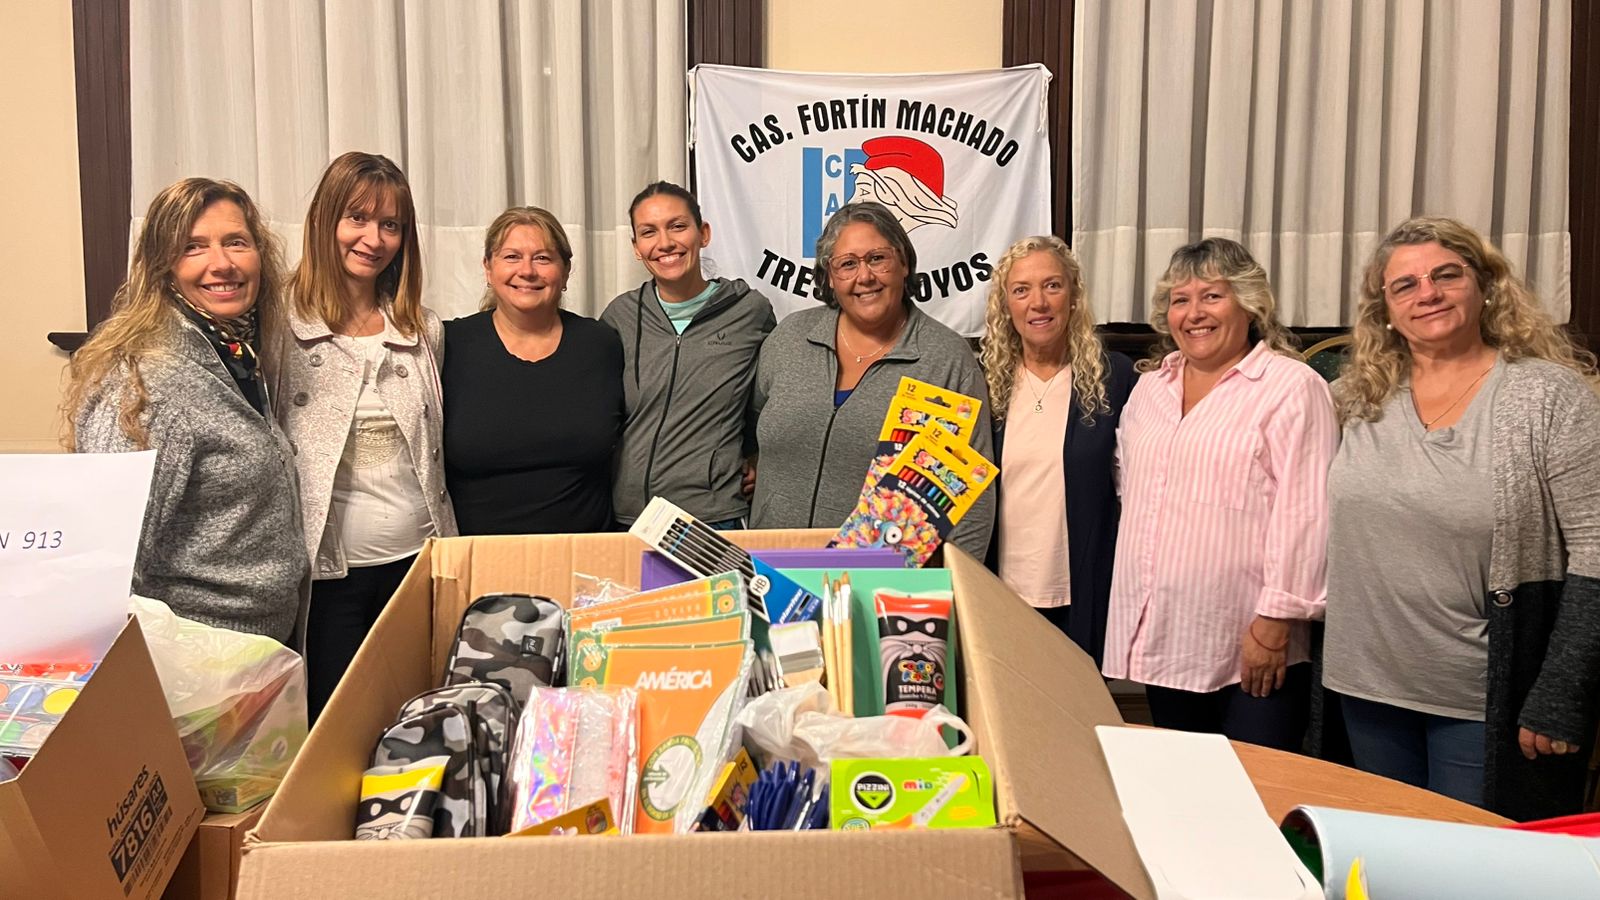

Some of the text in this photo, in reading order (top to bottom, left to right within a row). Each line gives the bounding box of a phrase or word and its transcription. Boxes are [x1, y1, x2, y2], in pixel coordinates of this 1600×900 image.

[730, 94, 1020, 168] CAS. FORTÍN MACHADO
[907, 384, 916, 392] 12
[932, 428, 942, 438] 12
[21, 530, 62, 549] 913
[753, 578, 767, 594] HB
[635, 666, 713, 690] AMÉRICA
[898, 684, 937, 695] TEMPERA
[856, 783, 890, 792] PIZZINI
[107, 764, 149, 838] húsares
[114, 805, 153, 874] 7816
[151, 780, 162, 803] A4
